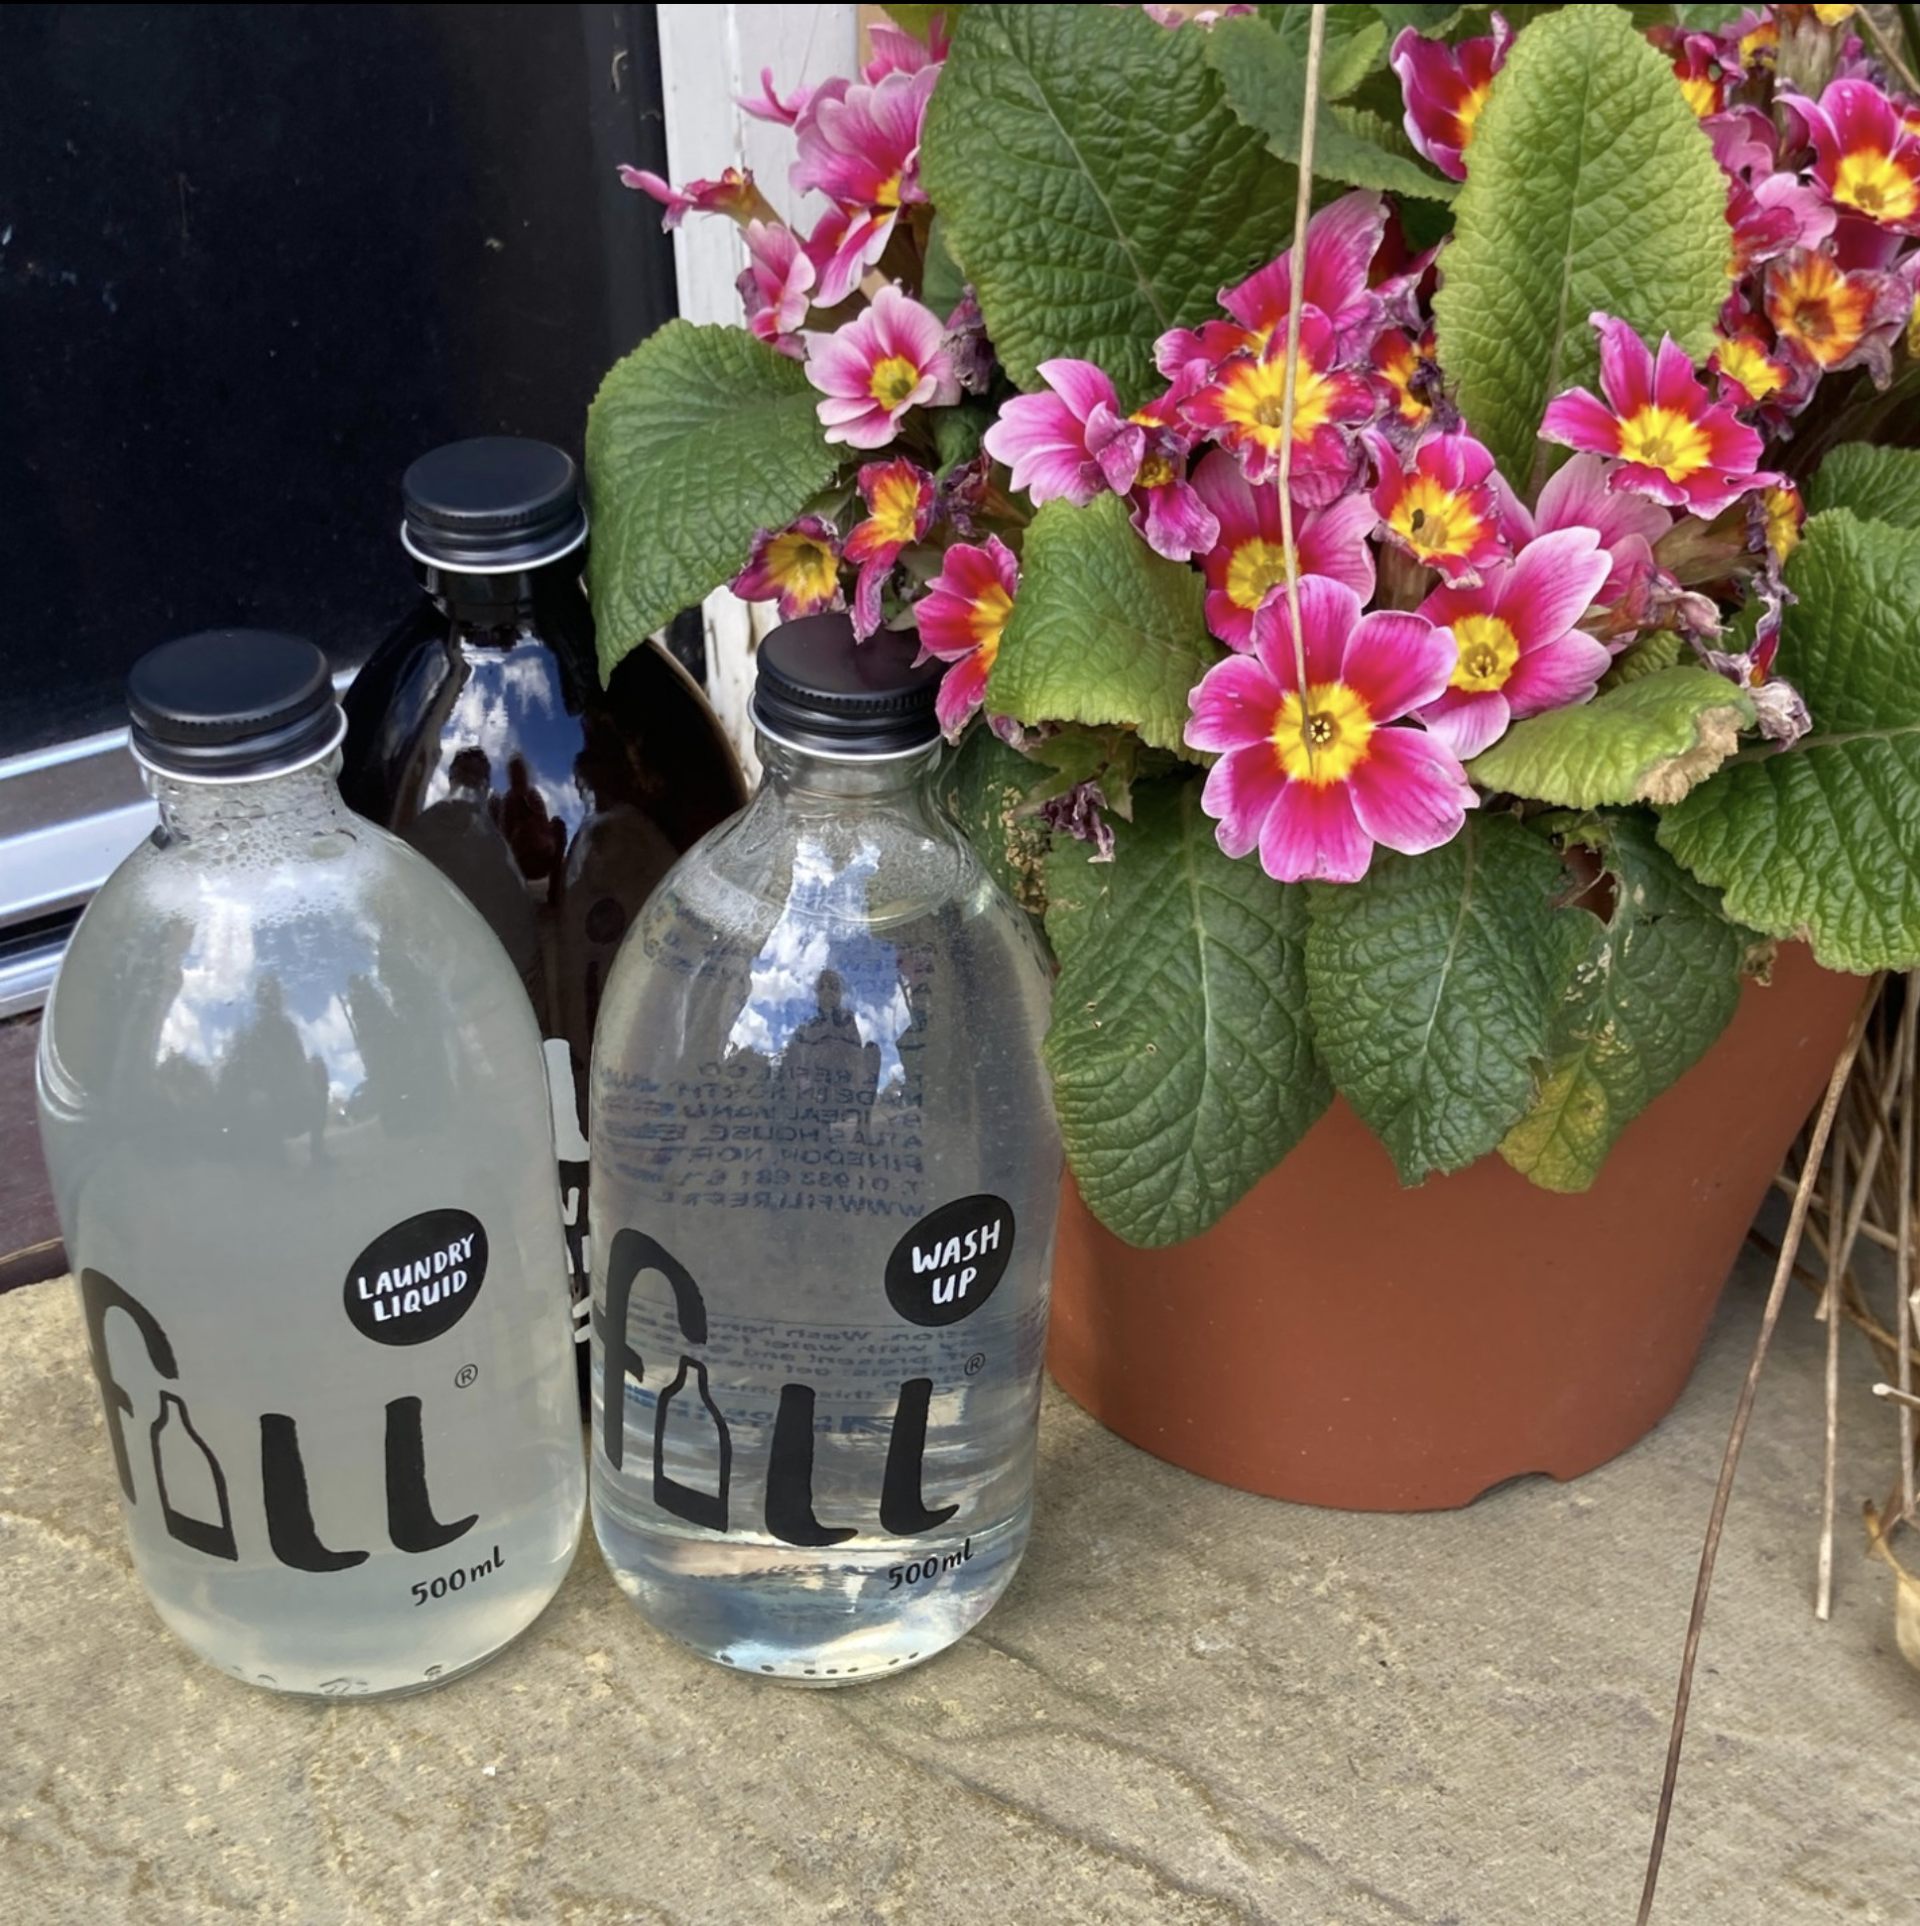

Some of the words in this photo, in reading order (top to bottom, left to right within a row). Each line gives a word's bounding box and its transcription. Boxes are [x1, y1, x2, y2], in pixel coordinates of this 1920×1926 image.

[358, 1232, 475, 1300] LAUNDRY
[912, 1219, 1001, 1275] WASH
[373, 1270, 468, 1322] LIQUID
[932, 1267, 978, 1304] UP
[411, 1546, 505, 1607] 500ml
[887, 1538, 974, 1591] 500ml
